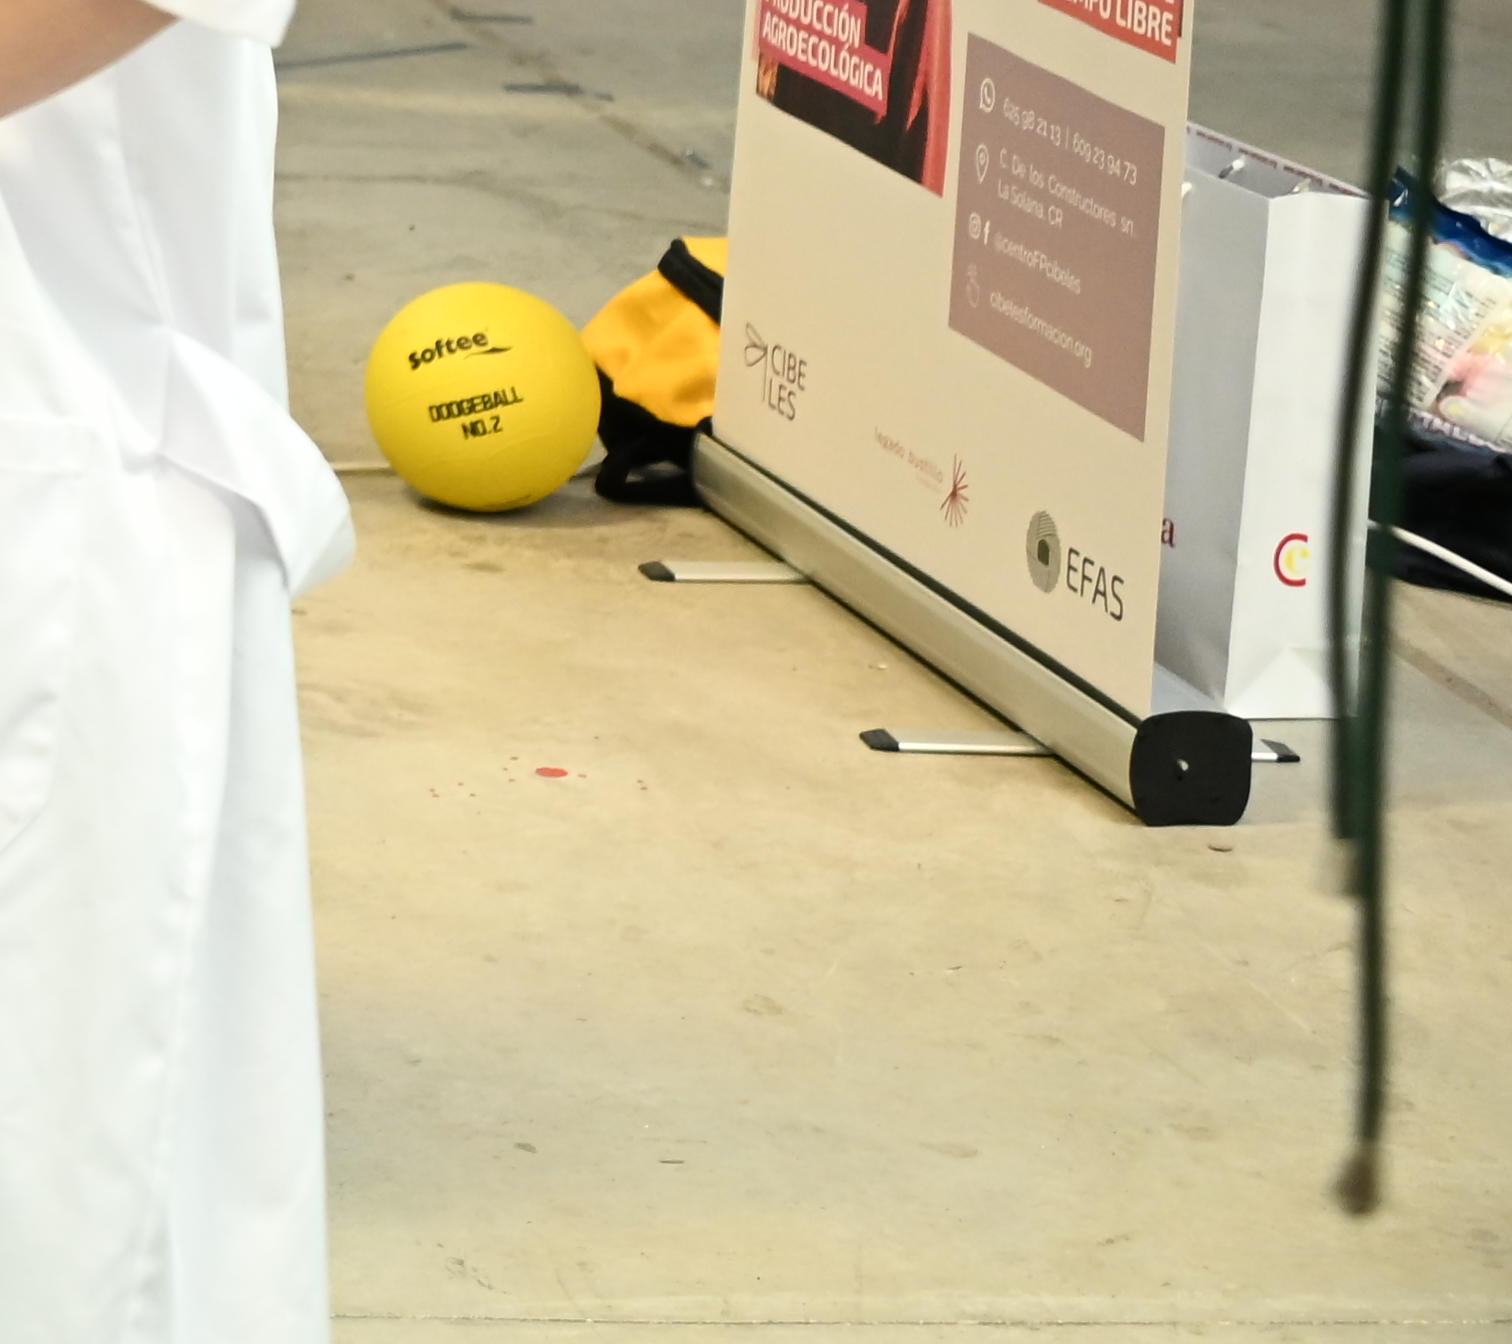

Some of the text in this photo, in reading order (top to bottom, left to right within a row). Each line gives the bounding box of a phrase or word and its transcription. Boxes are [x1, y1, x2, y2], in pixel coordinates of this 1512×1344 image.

[762, 11, 883, 101] AGROECOLÓGICA
[1072, 132, 1092, 163] 609
[1122, 160, 1138, 187] 73
[998, 178, 1010, 201] La
[1047, 204, 1064, 230] CR
[1011, 154, 1026, 179] De
[1028, 163, 1045, 190] los
[1047, 173, 1118, 229] Constructores
[407, 329, 490, 371] softee
[771, 344, 807, 392] CIBE
[429, 386, 524, 424] DODGEBALL
[768, 377, 796, 422] LES
[1066, 548, 1126, 624] EFAS
